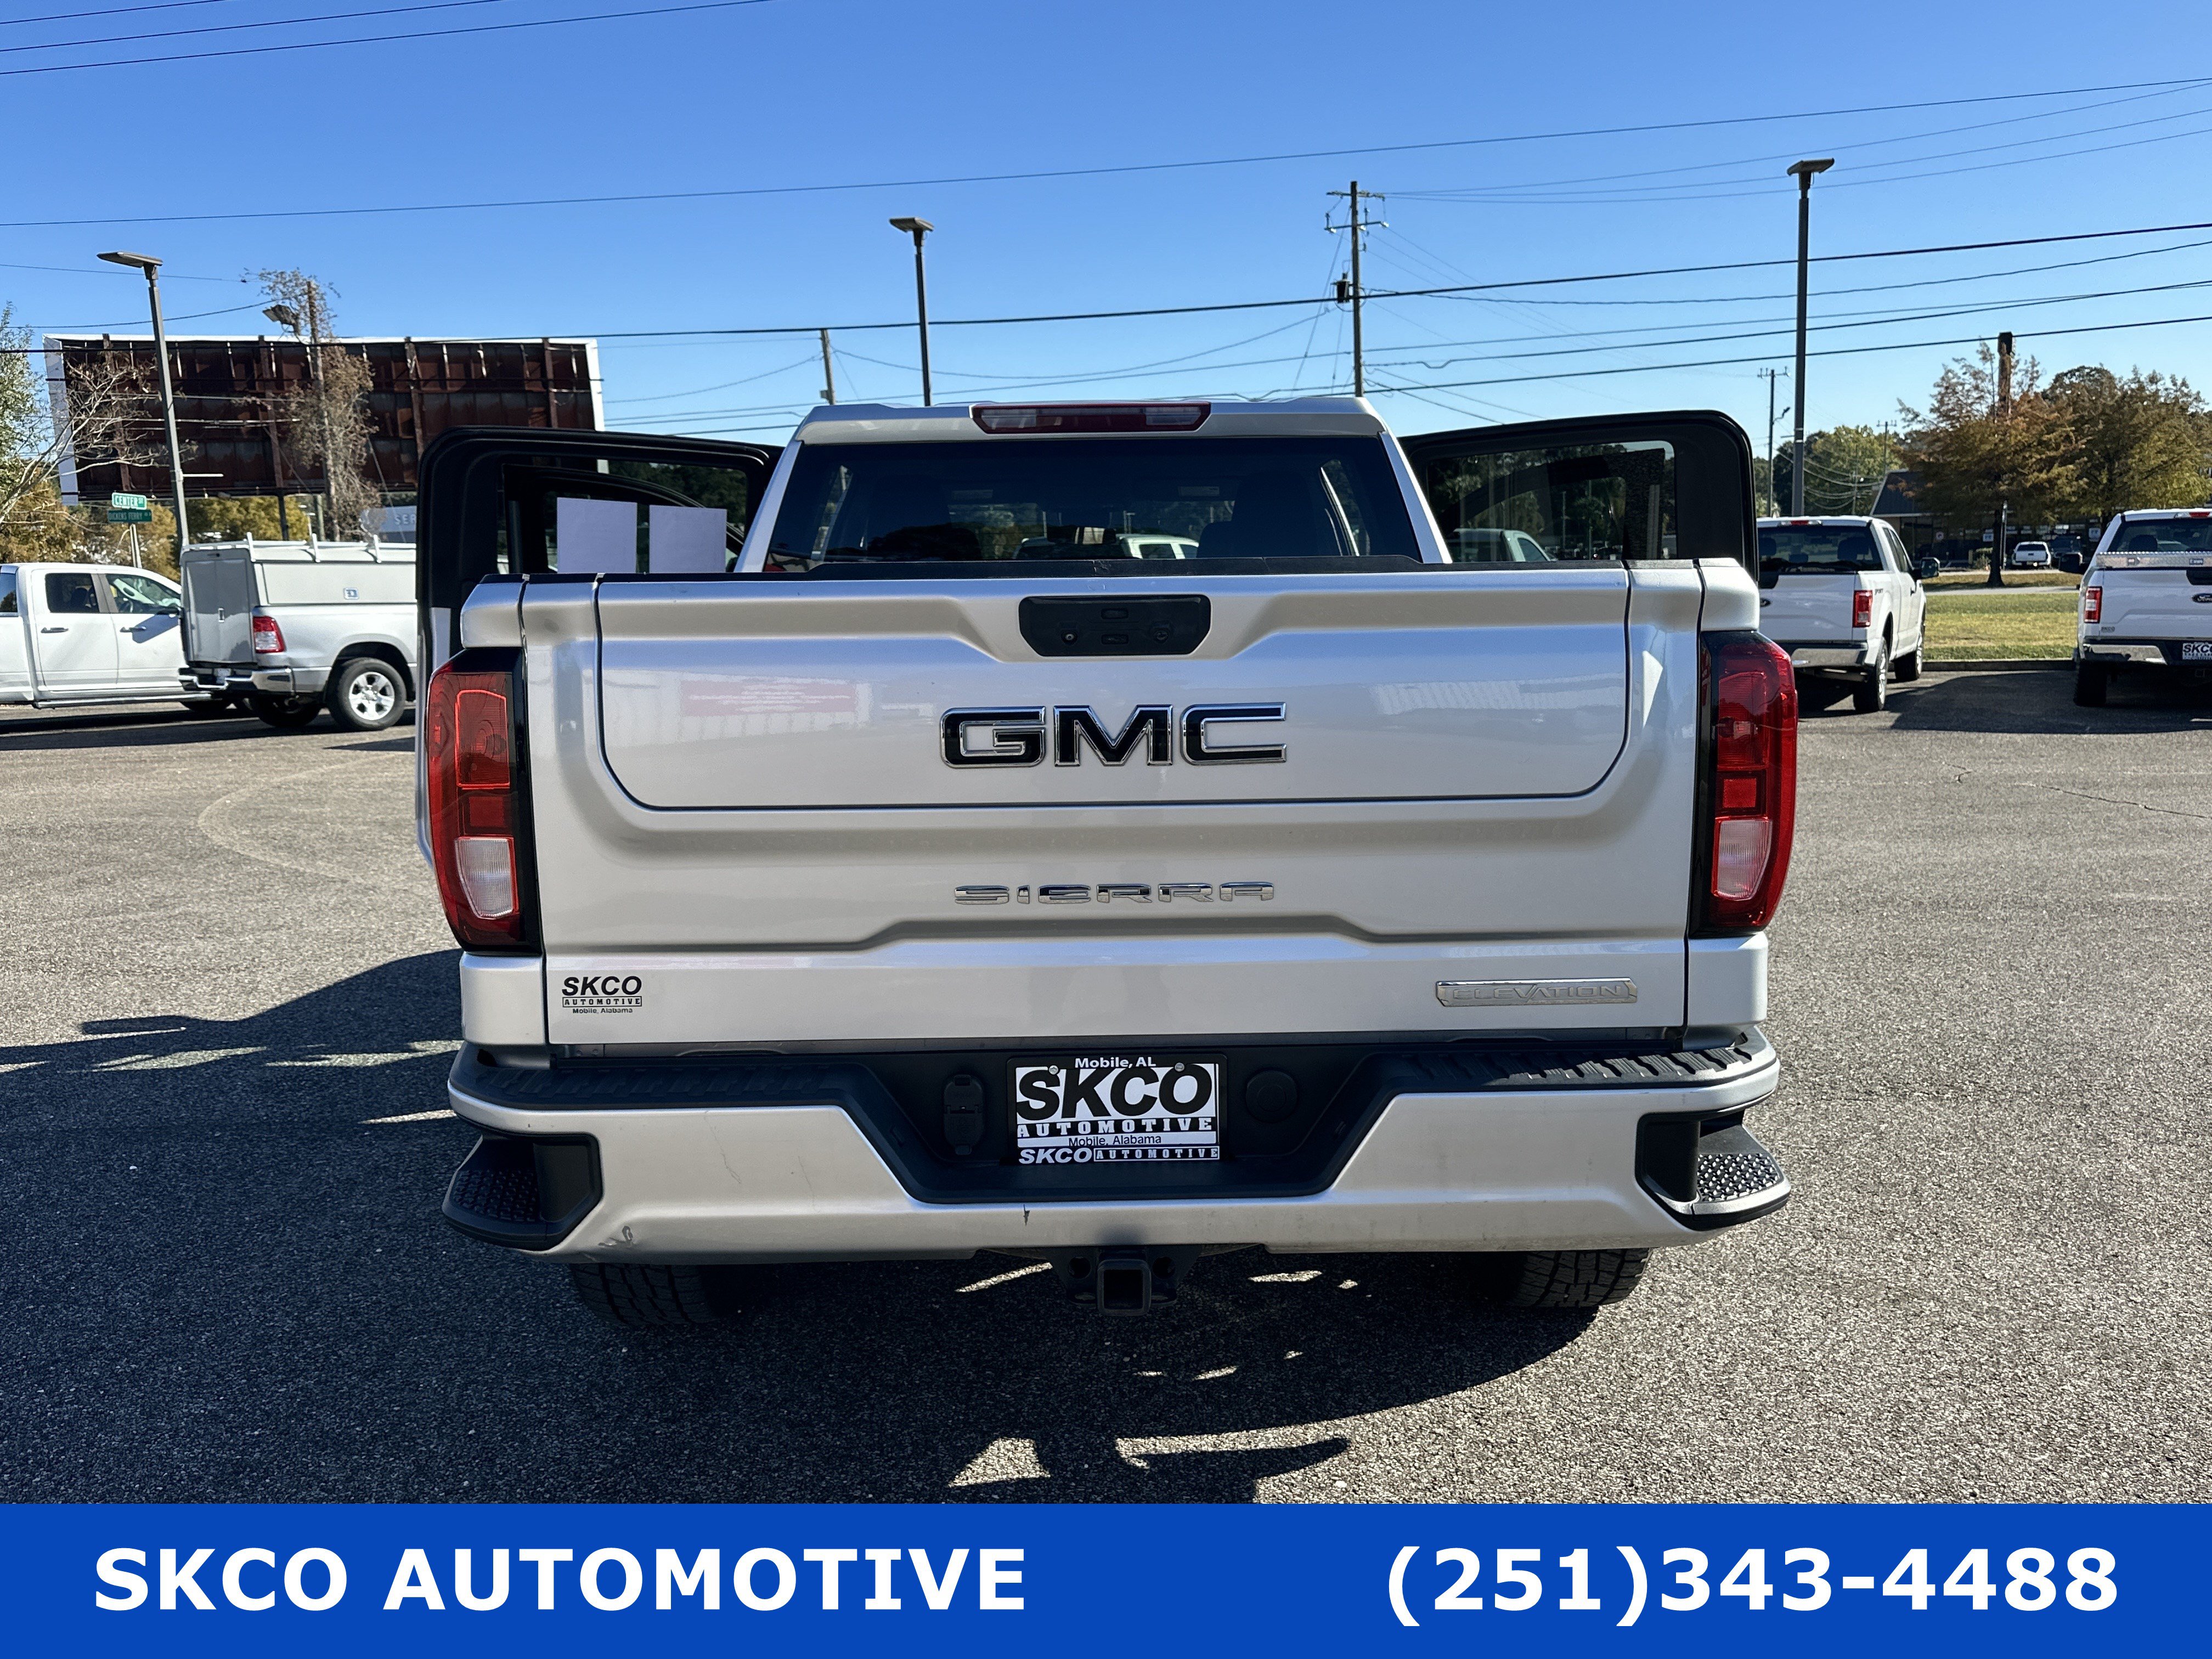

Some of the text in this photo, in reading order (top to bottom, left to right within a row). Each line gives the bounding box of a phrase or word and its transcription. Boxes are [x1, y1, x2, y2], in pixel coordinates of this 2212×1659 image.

[115, 495, 138, 507] CENTER
[2183, 645, 2212, 653] SKC
[940, 702, 1287, 769] GMC
[955, 881, 1274, 905] SIERRA
[562, 976, 642, 996] SKCO
[1453, 984, 1622, 1000] ELEVATION
[1075, 1057, 1156, 1069] Mobile, AL
[1017, 1063, 1212, 1121] SKCO
[1017, 1117, 1212, 1138] AUTOMOTIVE
[1113, 1135, 1161, 1144] Alabama
[1019, 1148, 1218, 1164] SKCO AUTOMOTIVE
